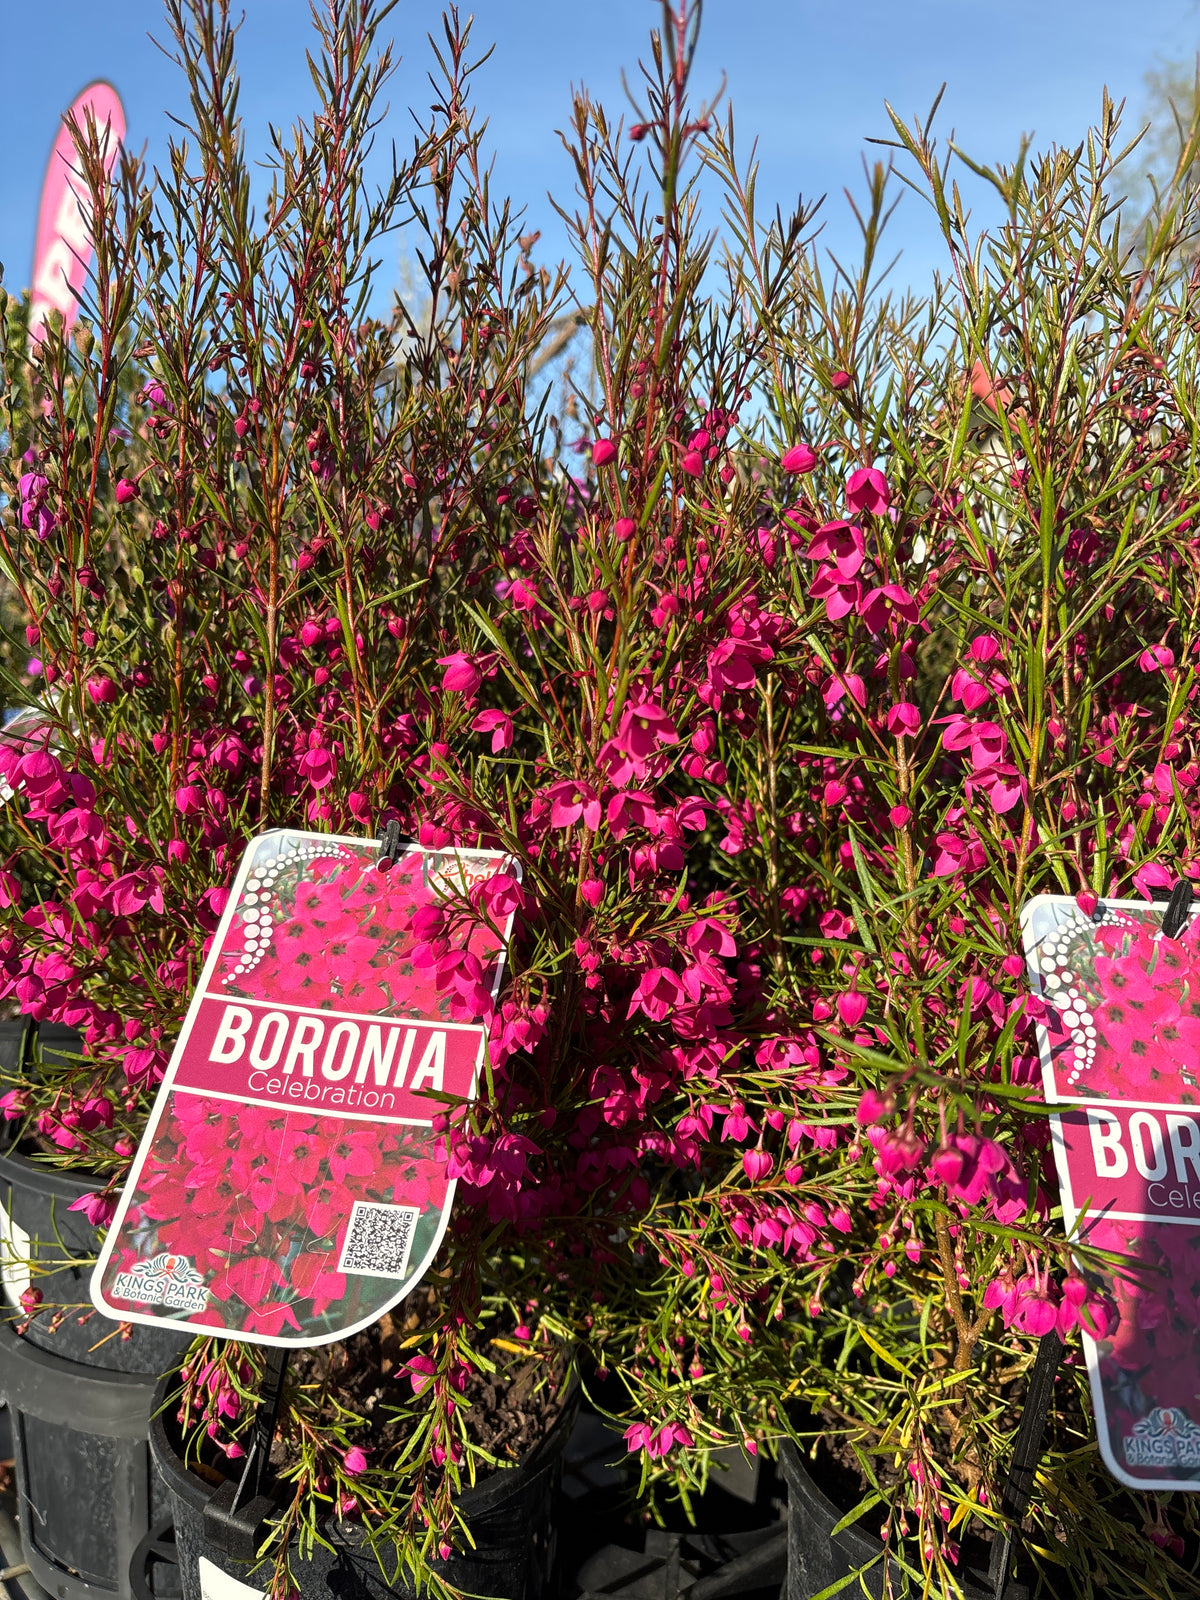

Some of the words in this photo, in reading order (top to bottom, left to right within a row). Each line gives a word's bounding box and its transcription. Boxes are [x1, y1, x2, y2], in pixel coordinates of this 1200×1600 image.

[208, 1004, 447, 1092] BORONIA
[248, 1071, 396, 1109] Celebration
[113, 1286, 121, 1295] &
[123, 1287, 163, 1303] Botanic
[165, 1295, 205, 1311] Garden
[116, 1274, 165, 1293] KINGS
[167, 1283, 208, 1301] PARK
[1125, 1438, 1173, 1454] KINGS
